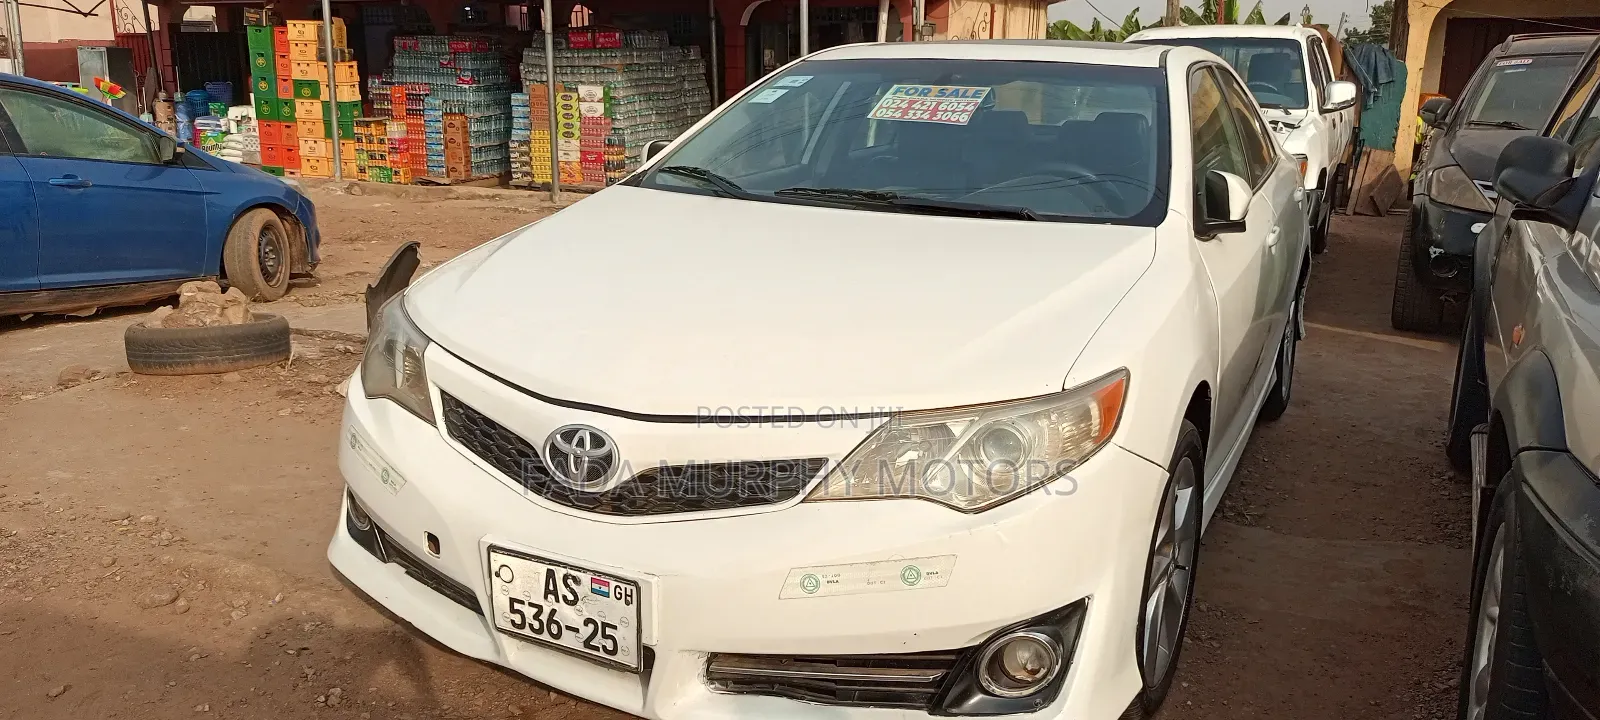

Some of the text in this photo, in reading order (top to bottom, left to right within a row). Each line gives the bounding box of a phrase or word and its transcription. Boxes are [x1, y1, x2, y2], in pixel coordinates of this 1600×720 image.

[891, 86, 986, 98] FOR SALE
[881, 98, 909, 109] 024
[911, 100, 936, 110] 421
[938, 101, 976, 111] 6054
[875, 108, 970, 122] 054 334 3066
[544, 568, 633, 606] AS GH
[509, 597, 618, 656] 536-25
